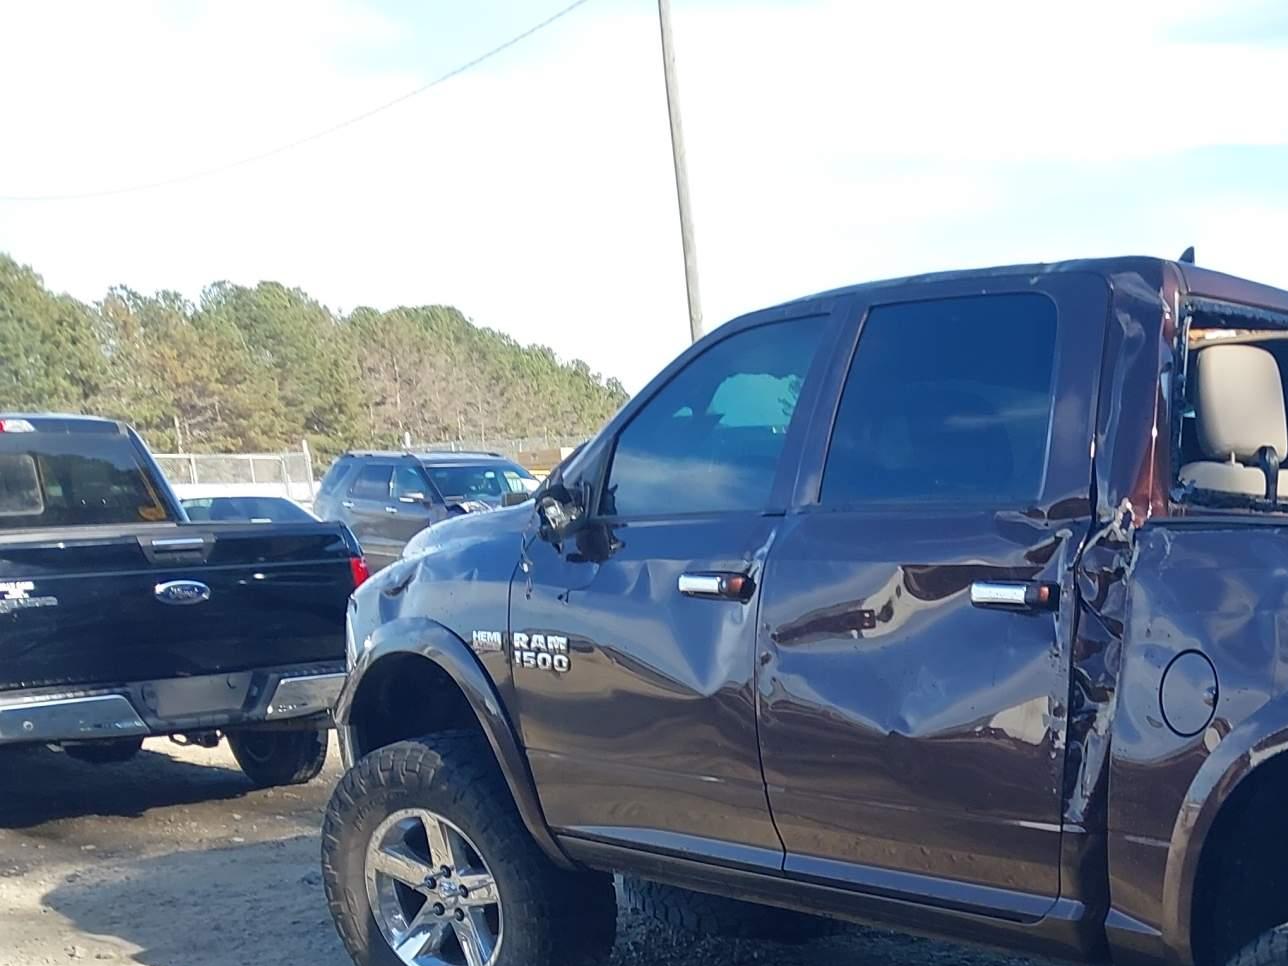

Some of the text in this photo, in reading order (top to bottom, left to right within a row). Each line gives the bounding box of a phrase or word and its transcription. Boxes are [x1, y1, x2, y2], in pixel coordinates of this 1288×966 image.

[473, 630, 501, 643] HEMI
[513, 632, 567, 651] RAM
[514, 650, 569, 672] 1500
